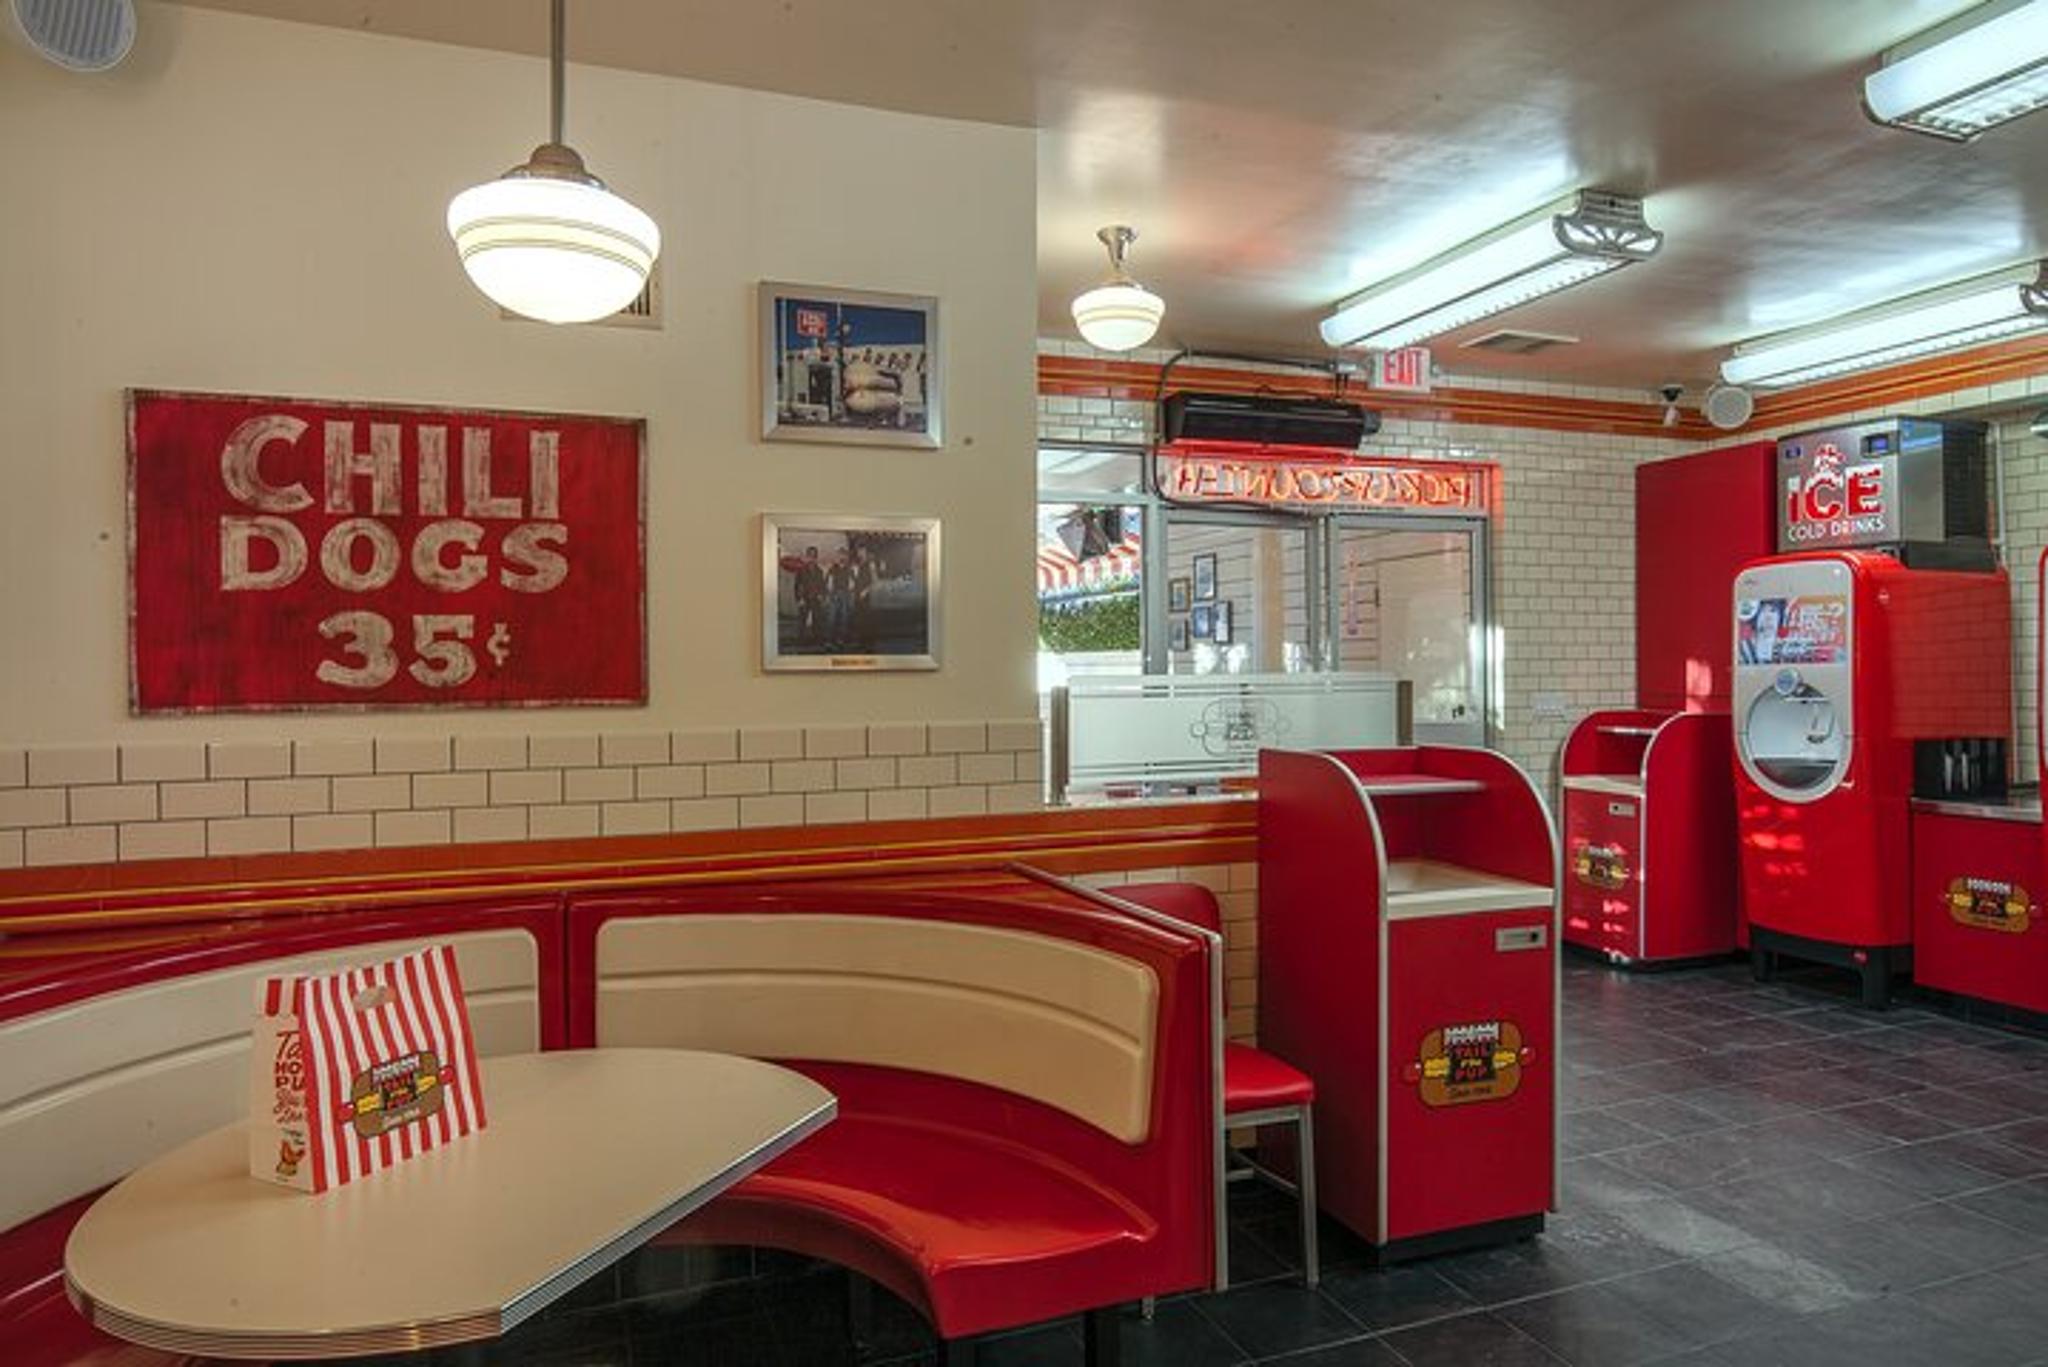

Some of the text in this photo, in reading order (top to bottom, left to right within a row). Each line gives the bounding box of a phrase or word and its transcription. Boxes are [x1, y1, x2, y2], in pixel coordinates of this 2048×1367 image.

[220, 414, 561, 520] CHILI
[1787, 463, 1885, 525] ICE
[219, 514, 569, 594] DOGS
[1788, 516, 1885, 542] COLD DRINKS
[315, 610, 511, 689] 35¢
